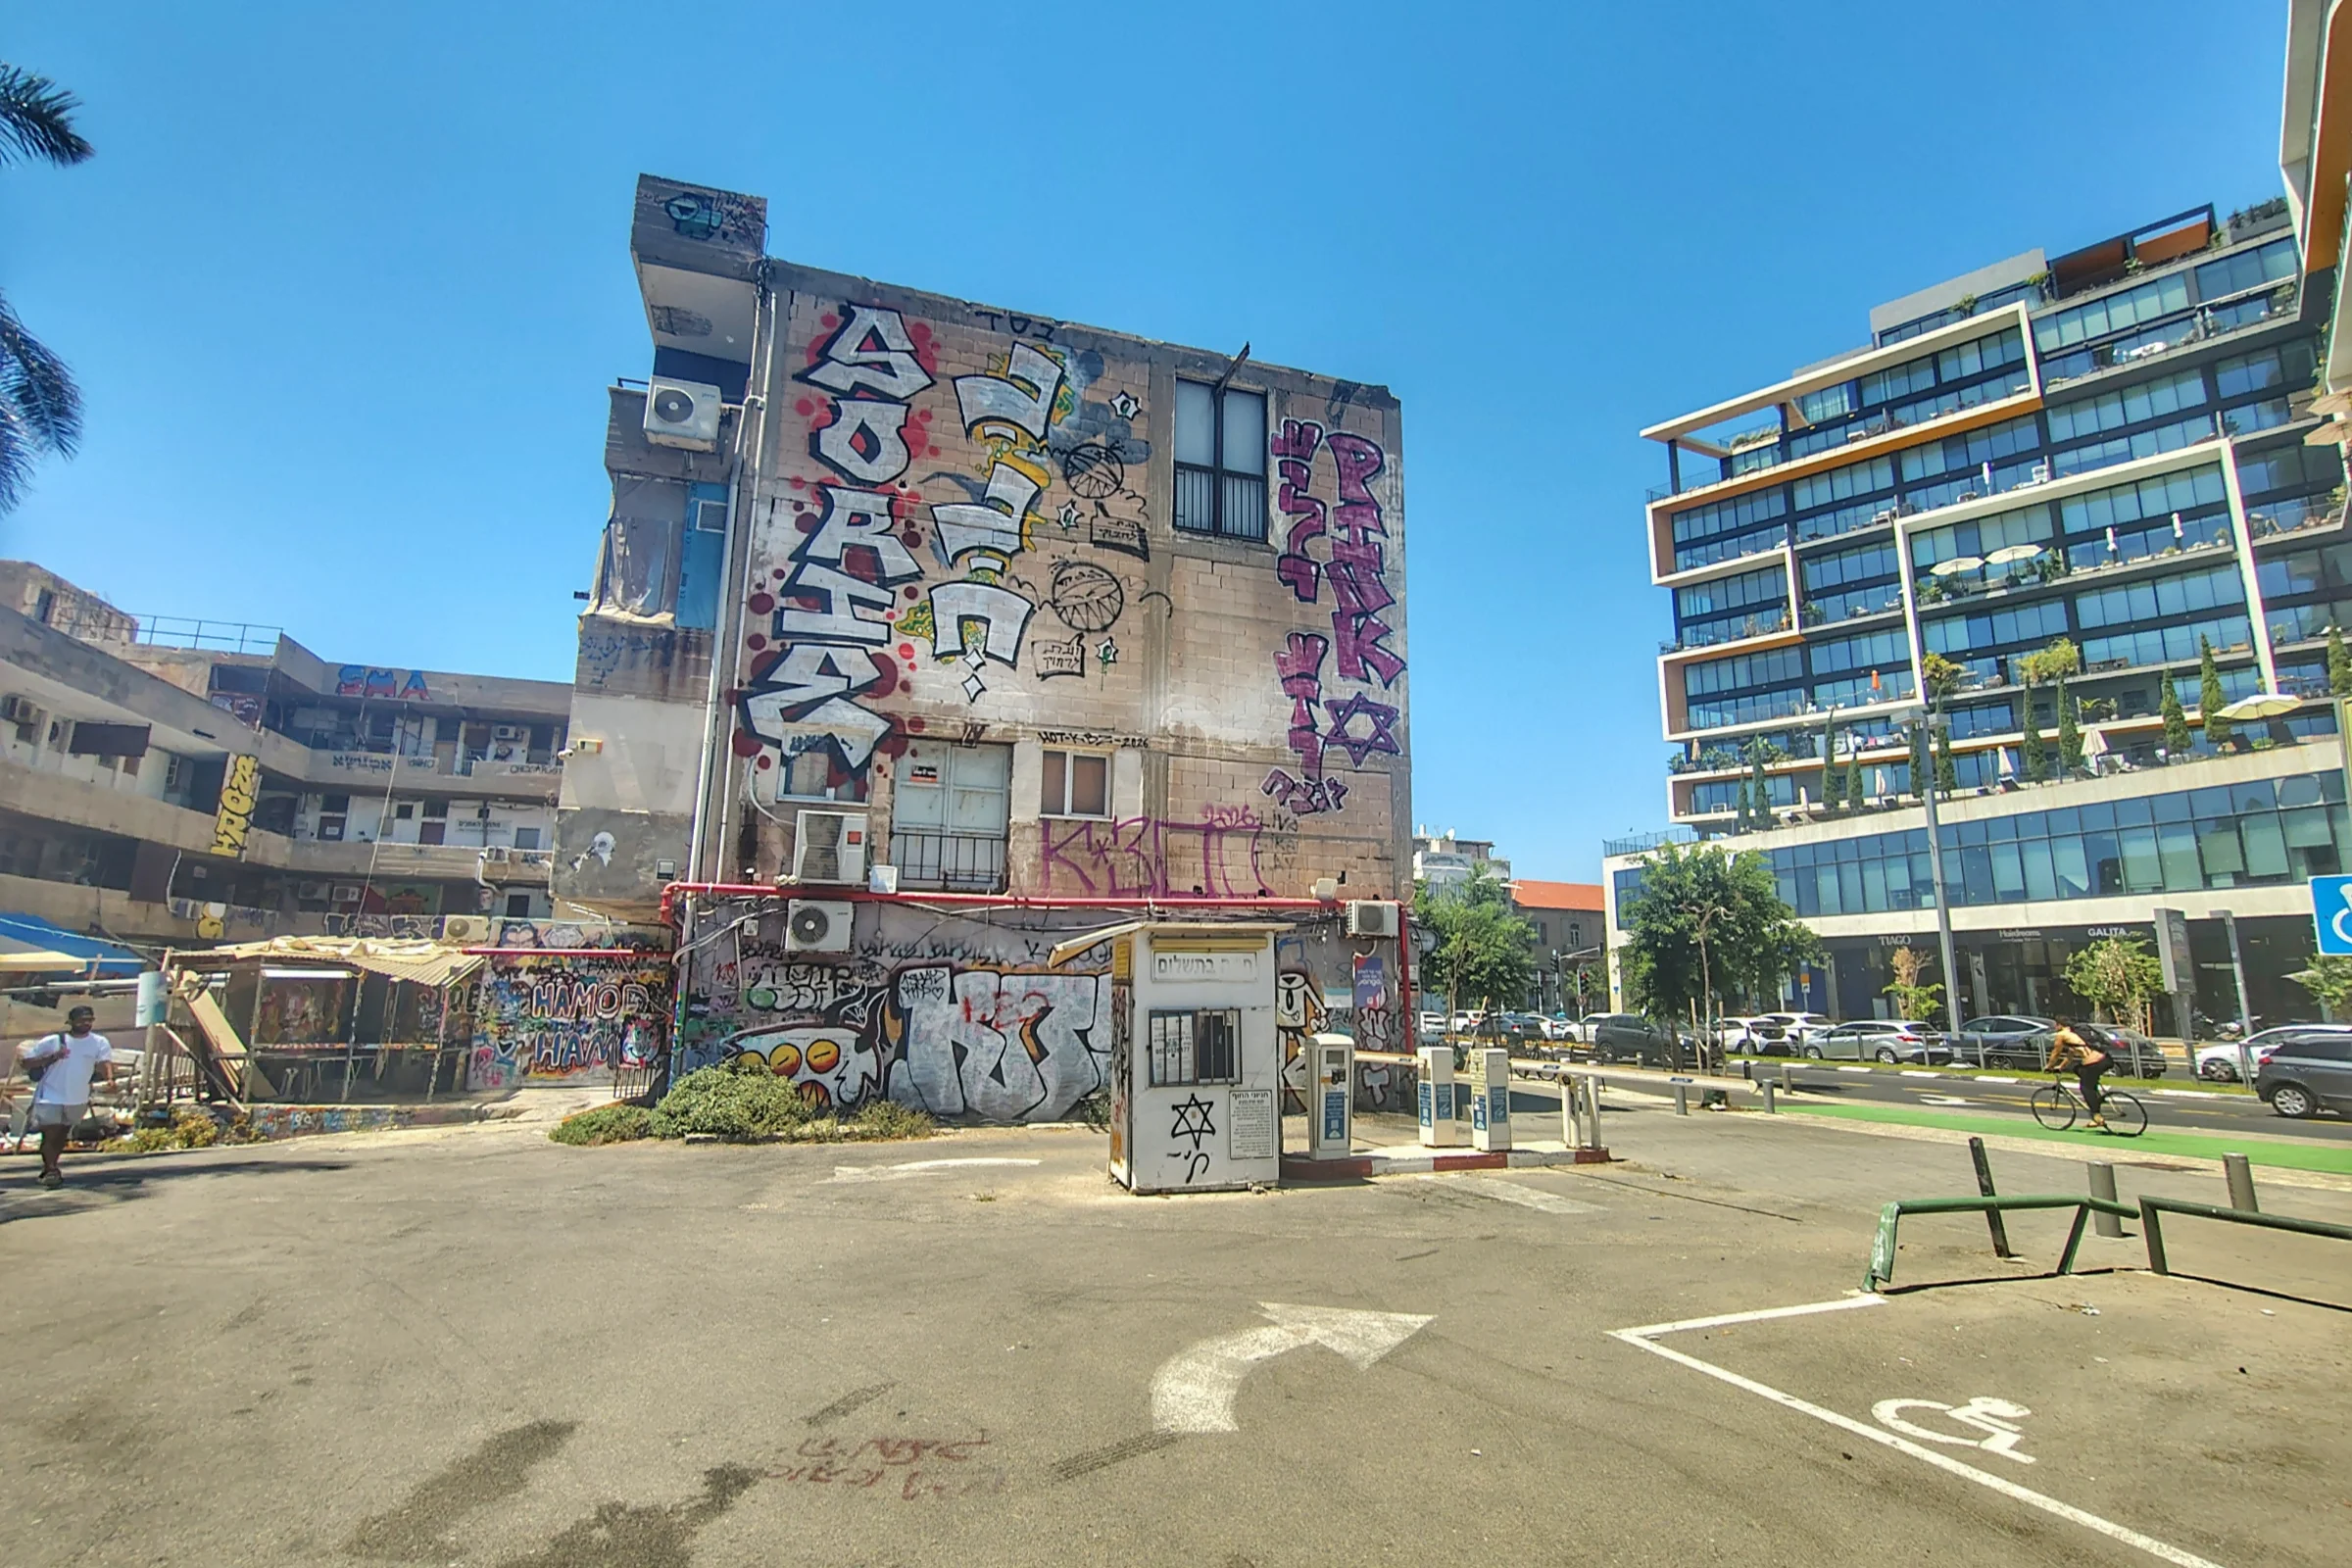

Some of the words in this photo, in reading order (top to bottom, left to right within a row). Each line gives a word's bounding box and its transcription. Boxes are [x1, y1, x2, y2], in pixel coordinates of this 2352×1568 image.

[1324, 431, 1408, 690] PINK
[1879, 935, 1912, 946] TIAGO
[1157, 955, 1216, 975] בתשלום
